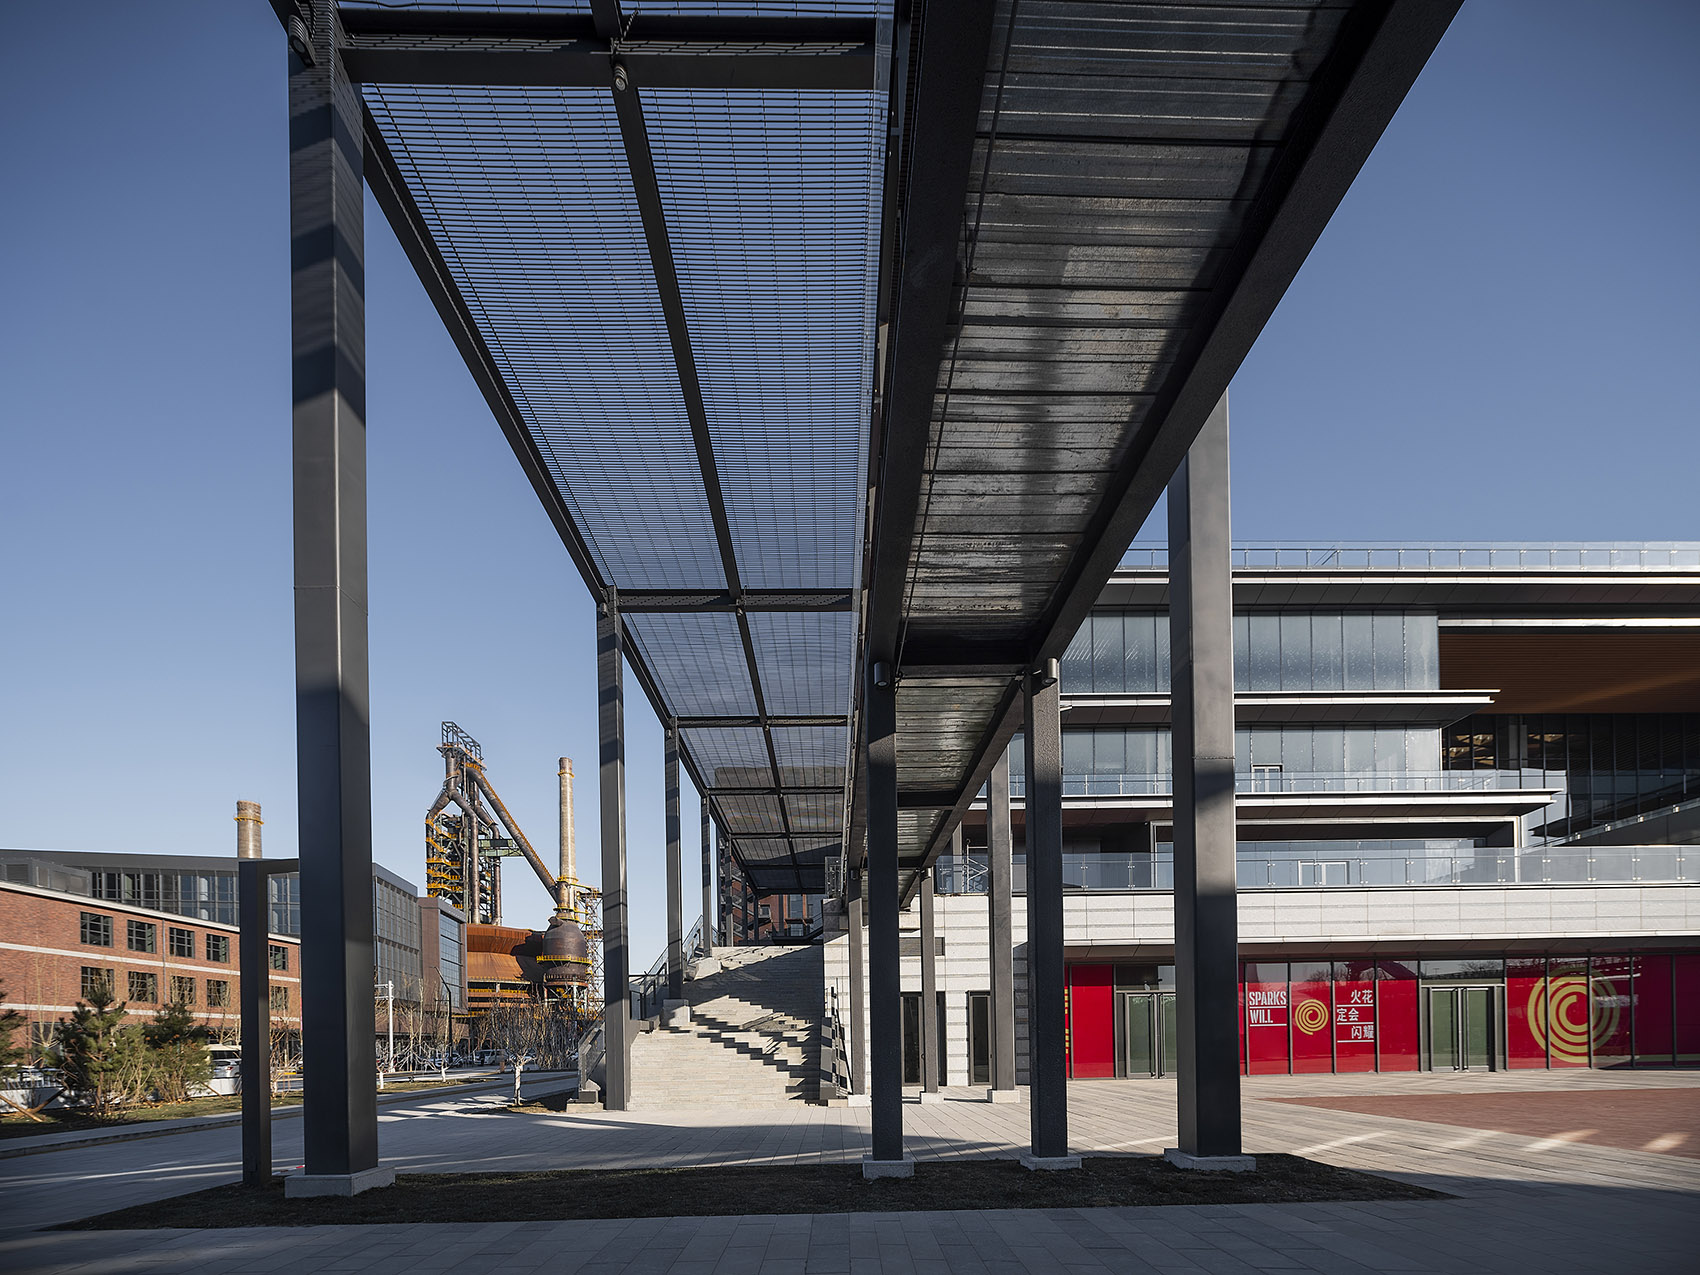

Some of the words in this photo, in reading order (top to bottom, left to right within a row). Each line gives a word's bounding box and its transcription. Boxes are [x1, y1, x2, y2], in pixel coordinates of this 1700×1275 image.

[1249, 991, 1286, 1006] SPARKS
[1351, 989, 1373, 1003] 火花
[1250, 1009, 1273, 1023] WILL
[1337, 1008, 1359, 1021] 定会
[1351, 1025, 1374, 1039] 闪耀
